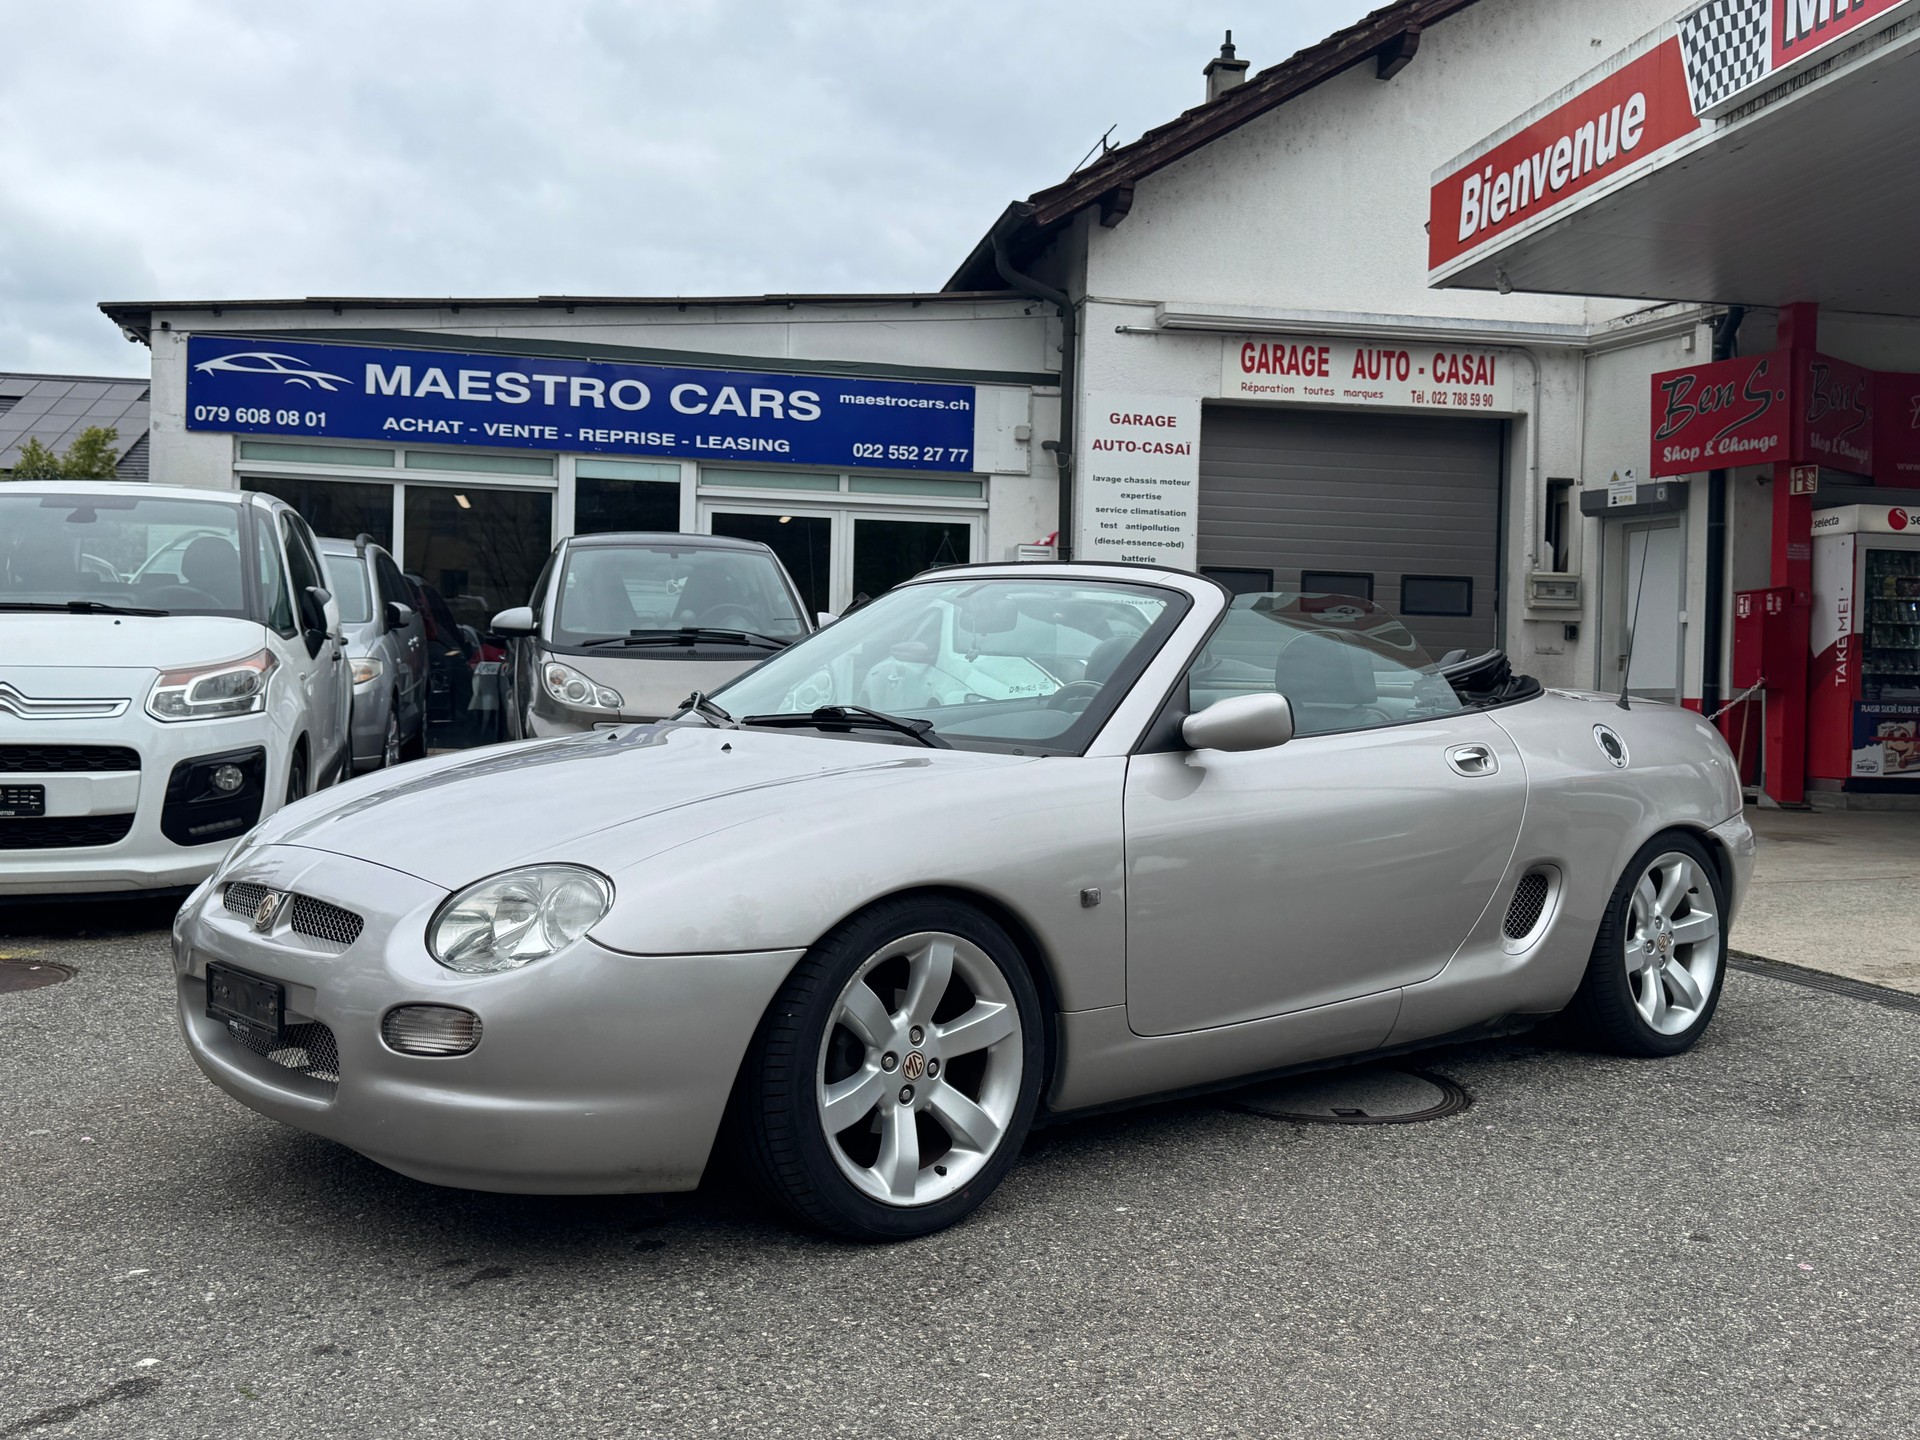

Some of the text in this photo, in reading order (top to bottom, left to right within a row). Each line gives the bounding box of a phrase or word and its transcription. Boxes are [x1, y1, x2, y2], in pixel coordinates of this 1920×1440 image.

[1458, 91, 1646, 242] Bienvenue
[1241, 342, 1330, 378] GARAGE
[1352, 349, 1410, 382] AUTO
[1432, 352, 1495, 386] CASAI
[365, 363, 822, 421] MAESTRO CARS
[1240, 381, 1384, 400] Réparation toutes marques
[1431, 391, 1447, 405] 022
[1452, 392, 1467, 406] 788
[1470, 393, 1480, 407] 59
[1482, 393, 1493, 407] 90
[839, 394, 970, 411] maestrocars.ch
[1654, 373, 1735, 441] Ben
[194, 405, 327, 427] 079 608 08 01
[1109, 412, 1177, 428] GARAGE
[382, 417, 464, 434] ACHAT
[483, 422, 559, 440] VENTE
[578, 428, 676, 447] REPRISE
[695, 435, 790, 453] LEASING
[852, 443, 969, 463] 022 552 27 77
[1092, 439, 1192, 456] AUTO-CASAÏ
[1662, 434, 1778, 463] Shop & Change
[1810, 432, 1831, 456] Shop
[1839, 440, 1869, 465] Change
[1092, 474, 1191, 486] lavage chassis moteur
[1120, 491, 1162, 501] expertise
[1095, 505, 1187, 517] service climatisation
[1100, 521, 1180, 532] test antipollution
[1813, 516, 1840, 530] selecta
[1094, 536, 1185, 549] (diesel-essence-obd)
[1121, 554, 1156, 563] batterie
[1835, 597, 1849, 687] TAKE ME!
[1898, 706, 1912, 714] POUR
[906, 1055, 922, 1076] MG
